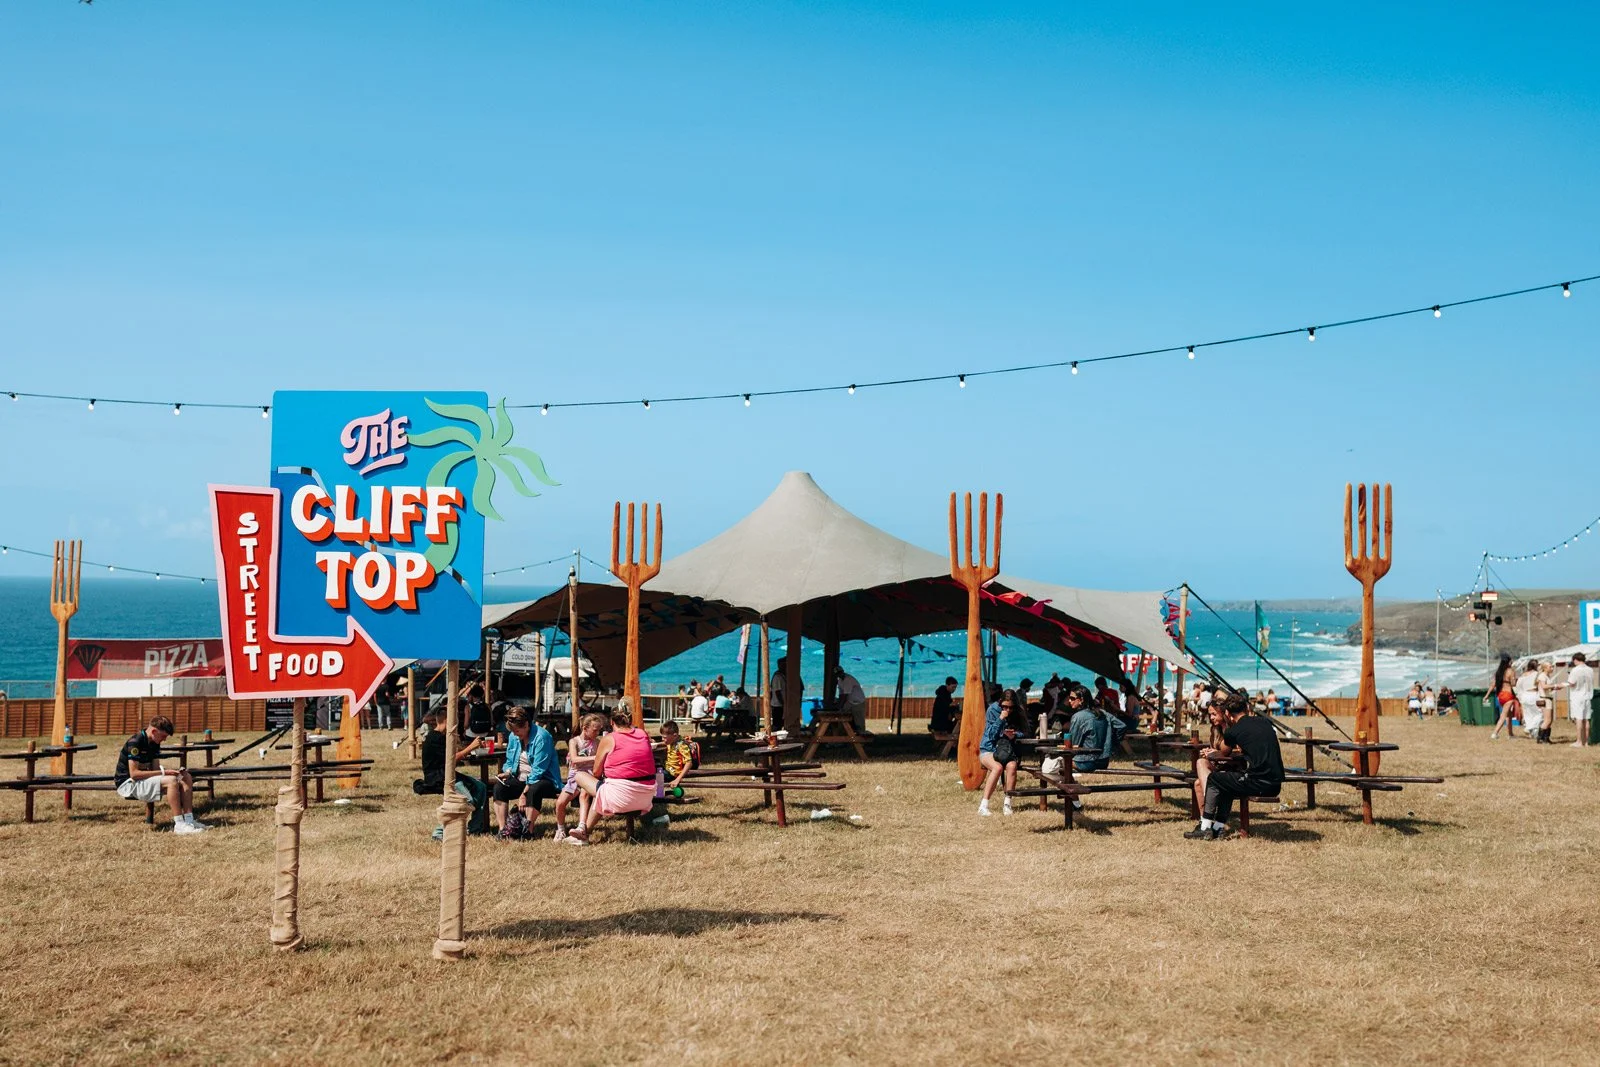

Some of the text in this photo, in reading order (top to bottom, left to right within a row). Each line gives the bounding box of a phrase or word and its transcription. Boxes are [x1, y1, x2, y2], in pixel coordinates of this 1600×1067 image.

[340, 408, 408, 465] THE
[291, 484, 463, 542] CLIFF
[237, 512, 261, 671] STREET
[316, 552, 436, 609] TOP
[144, 643, 208, 674] PIZZA
[269, 651, 343, 680] FOOD
